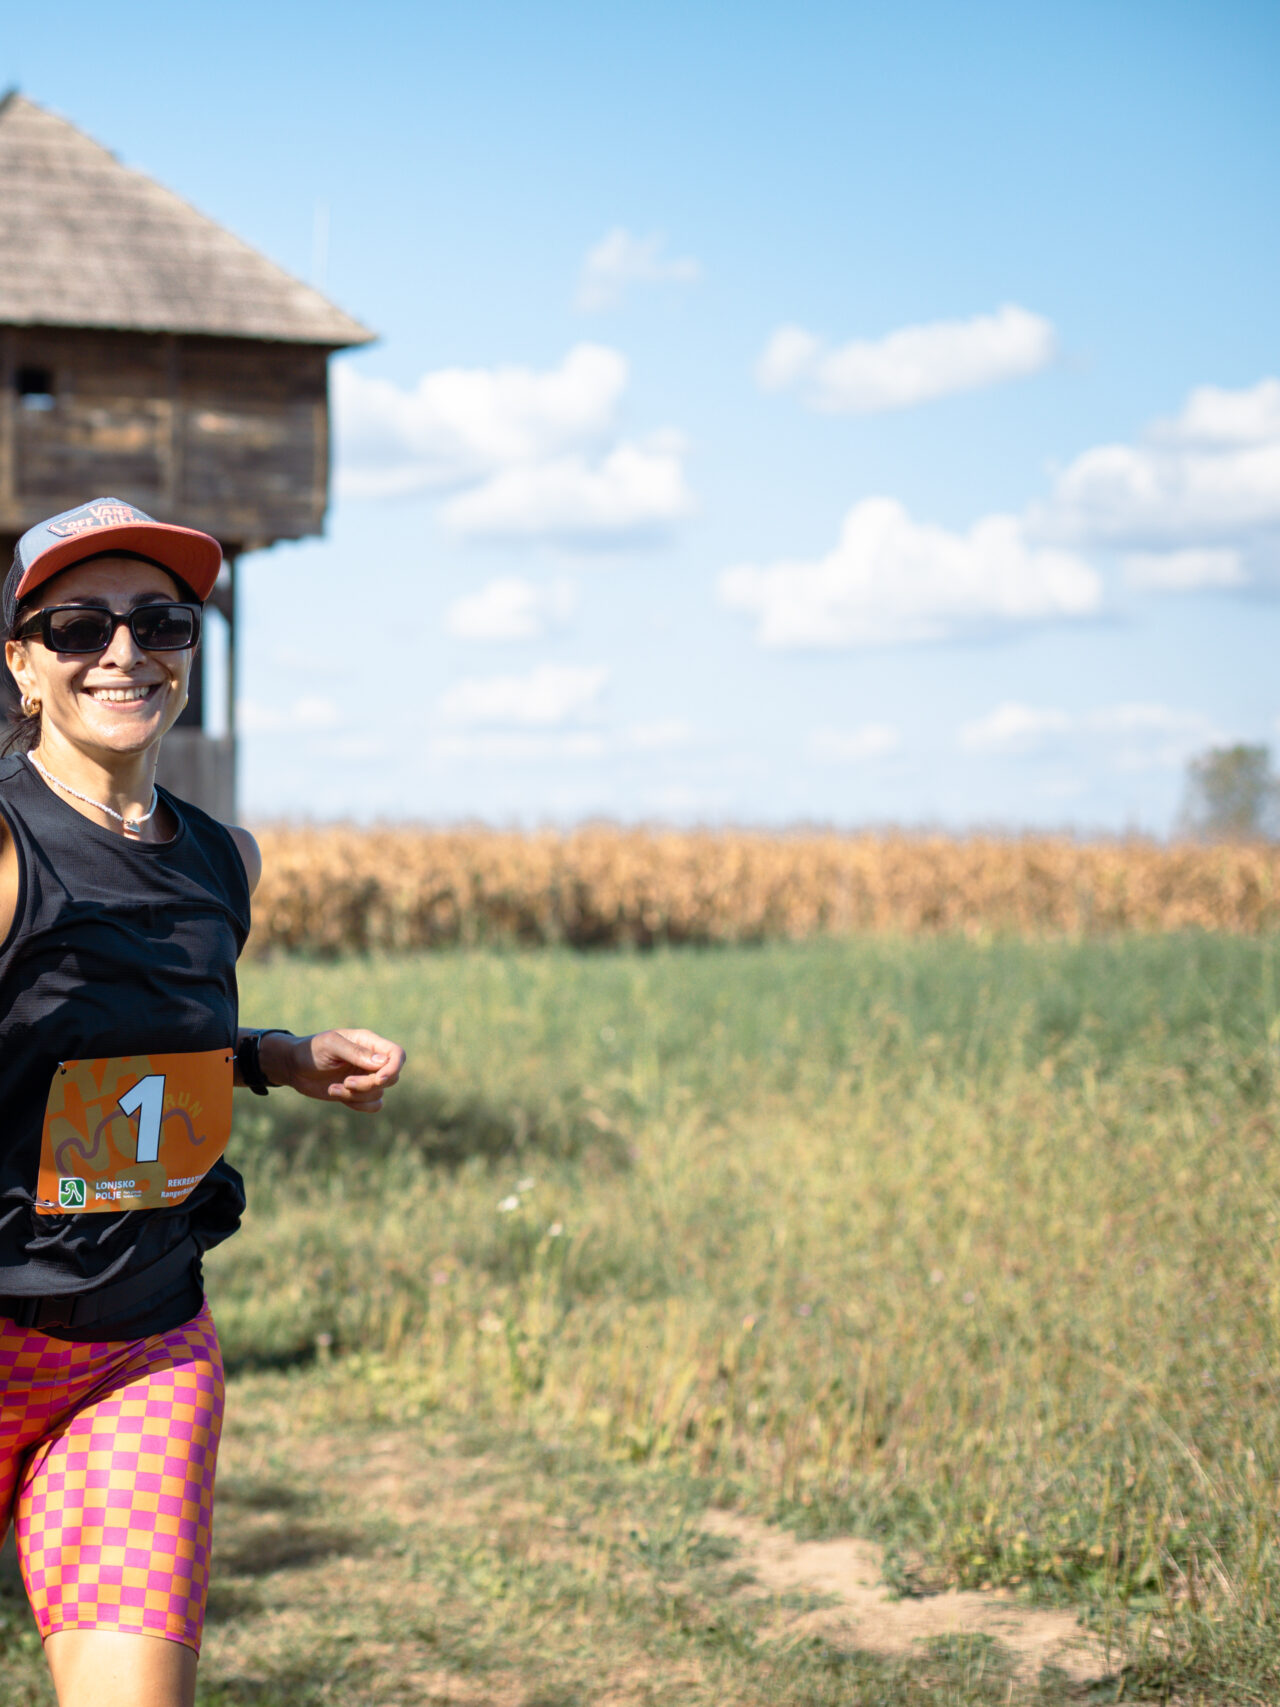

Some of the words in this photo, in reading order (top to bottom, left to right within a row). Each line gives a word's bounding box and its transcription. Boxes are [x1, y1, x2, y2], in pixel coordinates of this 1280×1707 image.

[87, 505, 131, 519] VANS
[117, 1074, 167, 1163] 1
[96, 1180, 135, 1190] LONJSKO
[96, 1191, 121, 1200] POLJE
